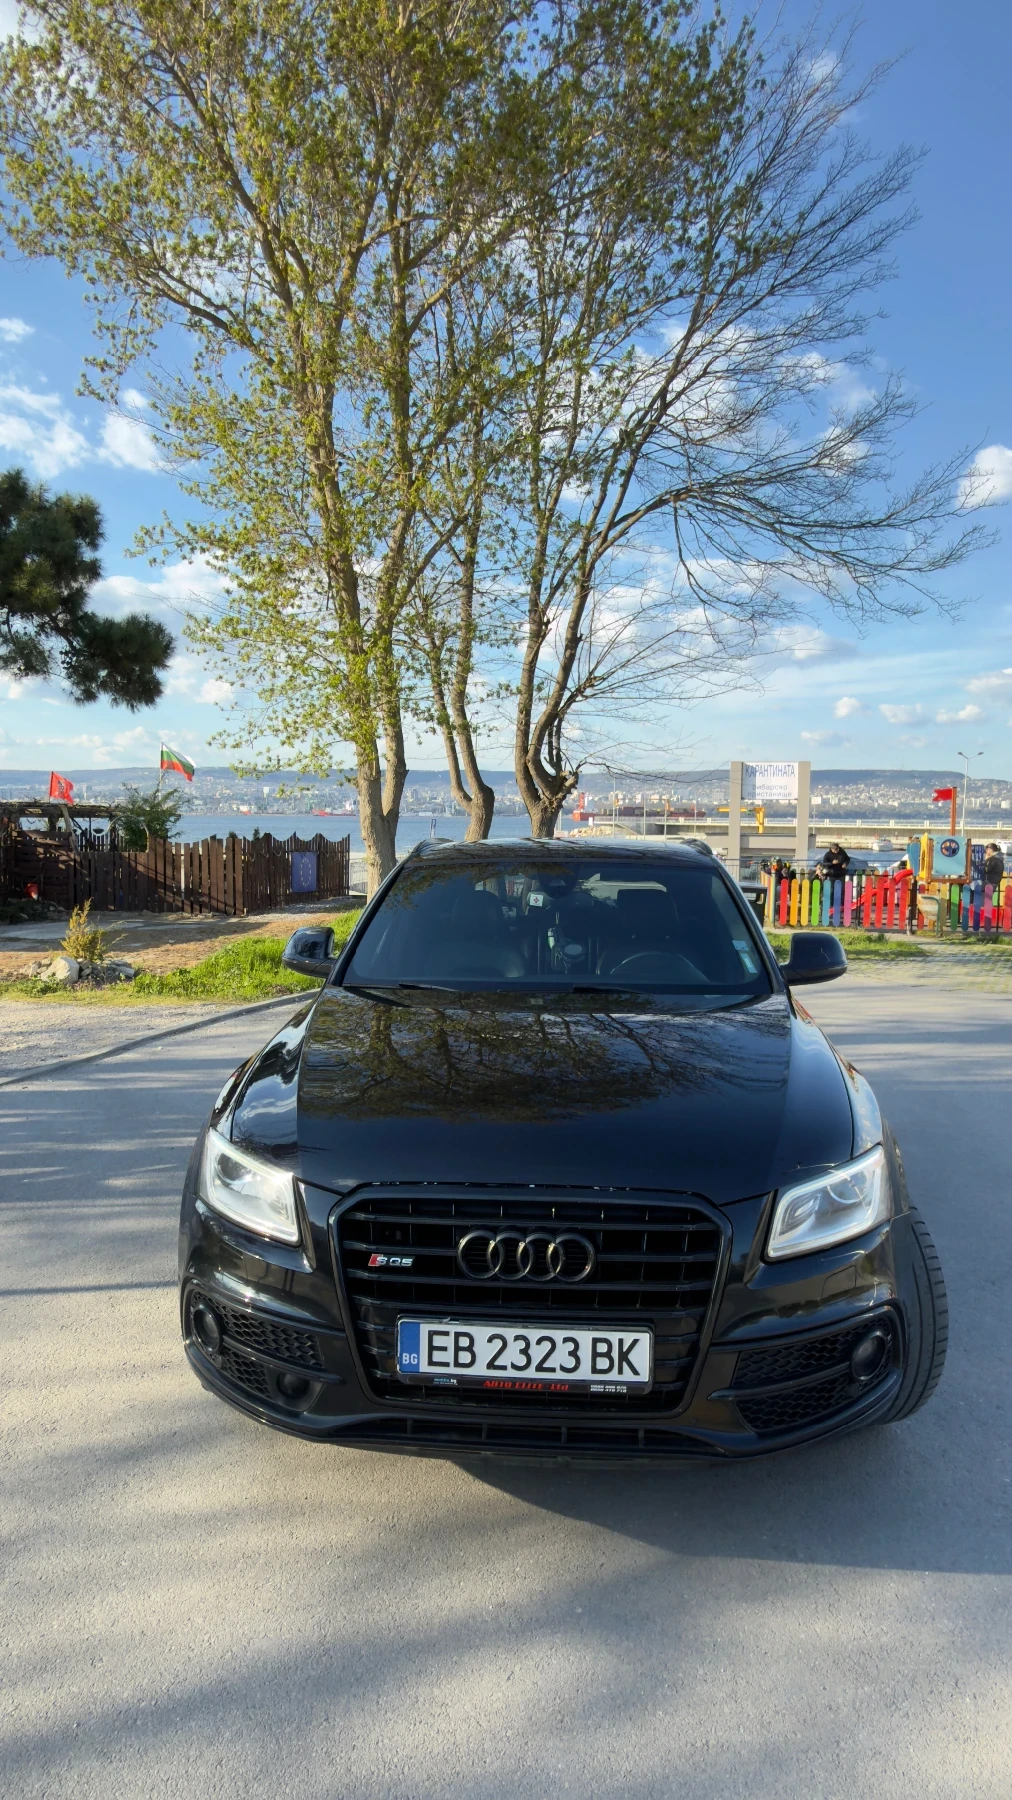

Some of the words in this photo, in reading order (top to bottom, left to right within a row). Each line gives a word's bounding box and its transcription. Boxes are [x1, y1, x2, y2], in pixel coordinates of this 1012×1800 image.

[745, 765, 795, 777] КАРАНТИНАТА
[376, 1256, 413, 1267] SQ5
[402, 1352, 418, 1365] BG
[428, 1330, 476, 1368] EB
[486, 1334, 581, 1373] 2323
[590, 1338, 640, 1375] BK
